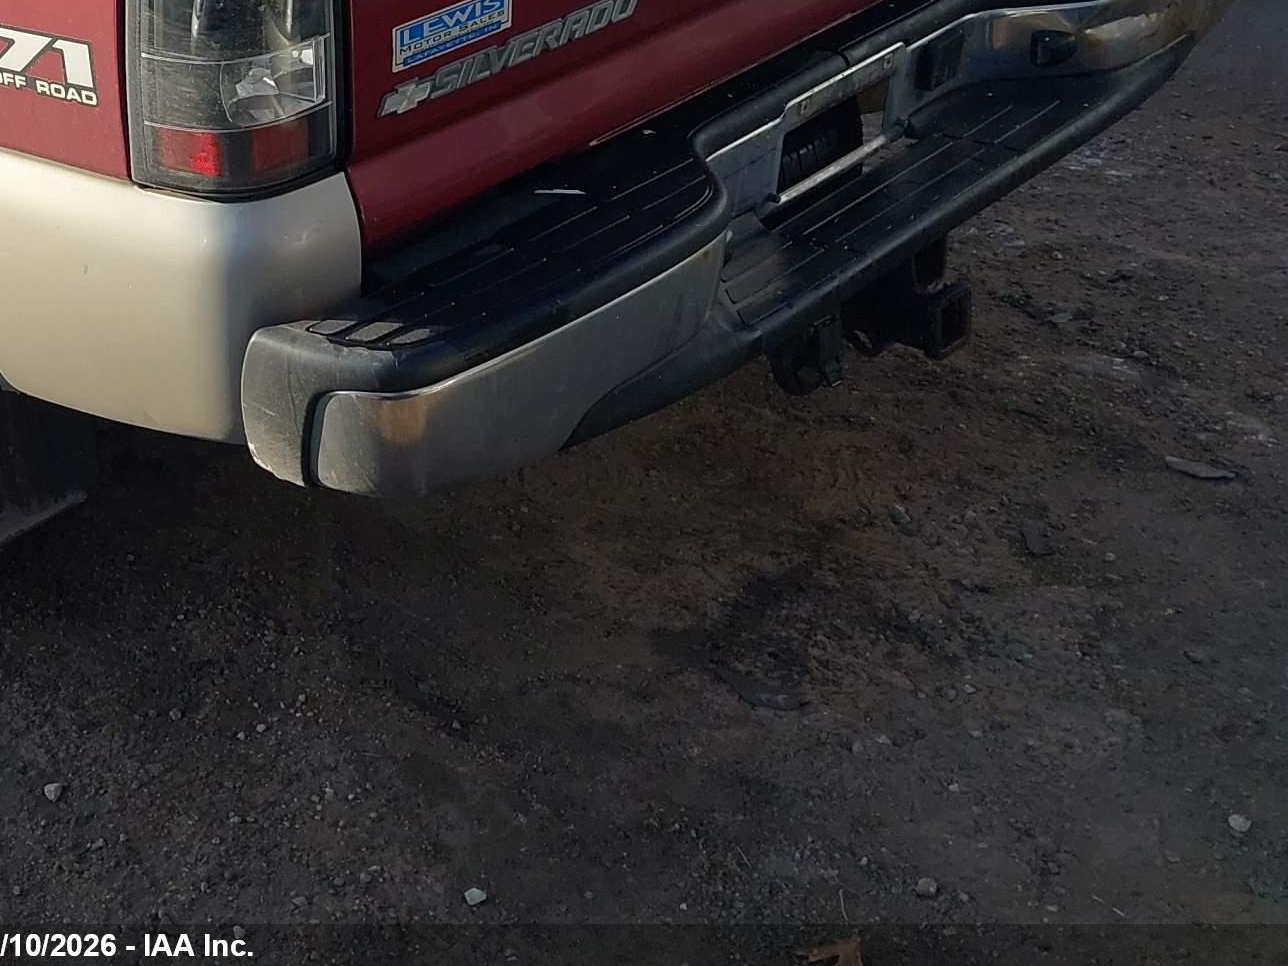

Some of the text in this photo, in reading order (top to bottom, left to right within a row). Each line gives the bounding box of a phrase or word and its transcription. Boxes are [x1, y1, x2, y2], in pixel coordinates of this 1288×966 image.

[398, 29, 453, 55] MOTOR
[457, 8, 506, 33] SALES
[35, 80, 99, 107] ROAD
